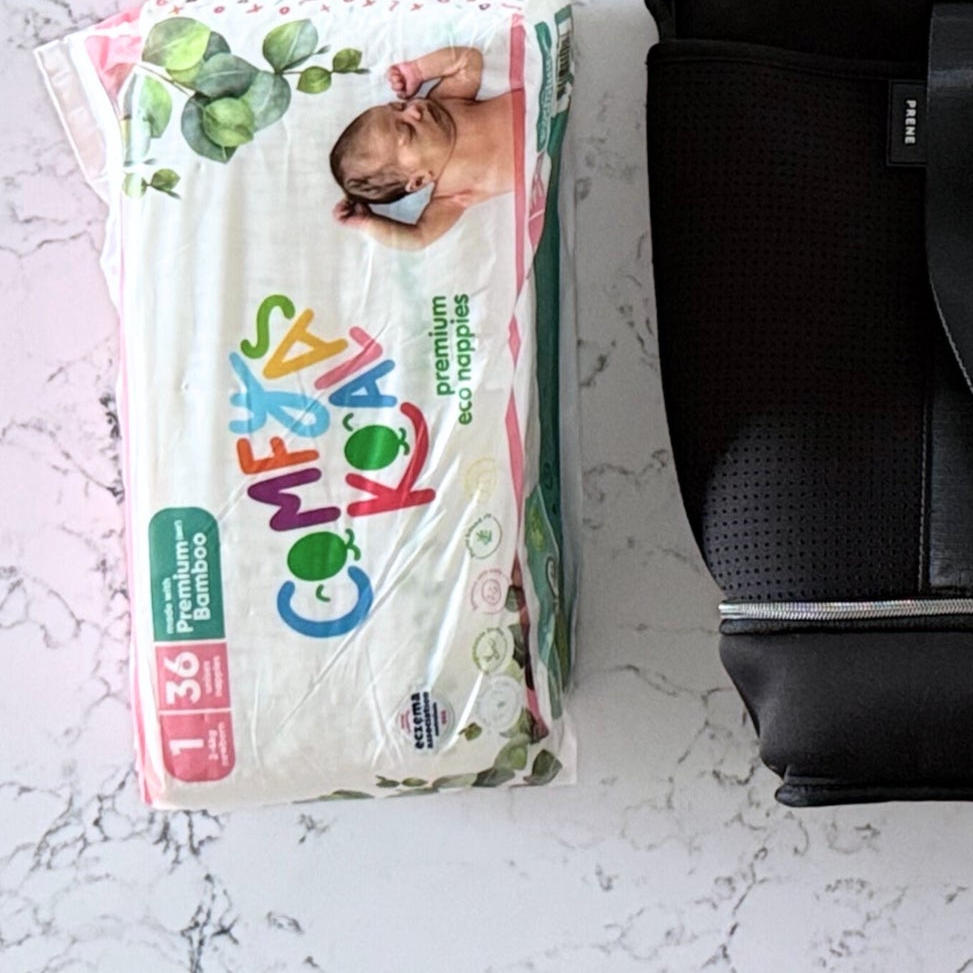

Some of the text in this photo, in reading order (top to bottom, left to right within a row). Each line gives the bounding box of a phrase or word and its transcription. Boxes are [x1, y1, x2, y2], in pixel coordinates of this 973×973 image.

[904, 99, 917, 144] PRENE
[428, 296, 456, 396] premium
[450, 294, 476, 425] eco nappies
[241, 294, 436, 517] KOALAS
[229, 352, 374, 638] COMFY
[172, 541, 194, 633] Premium
[191, 532, 212, 621] Bamboo
[163, 652, 202, 705] 36
[410, 692, 425, 749] eczema
[422, 691, 434, 749] association
[168, 738, 204, 757] 1
